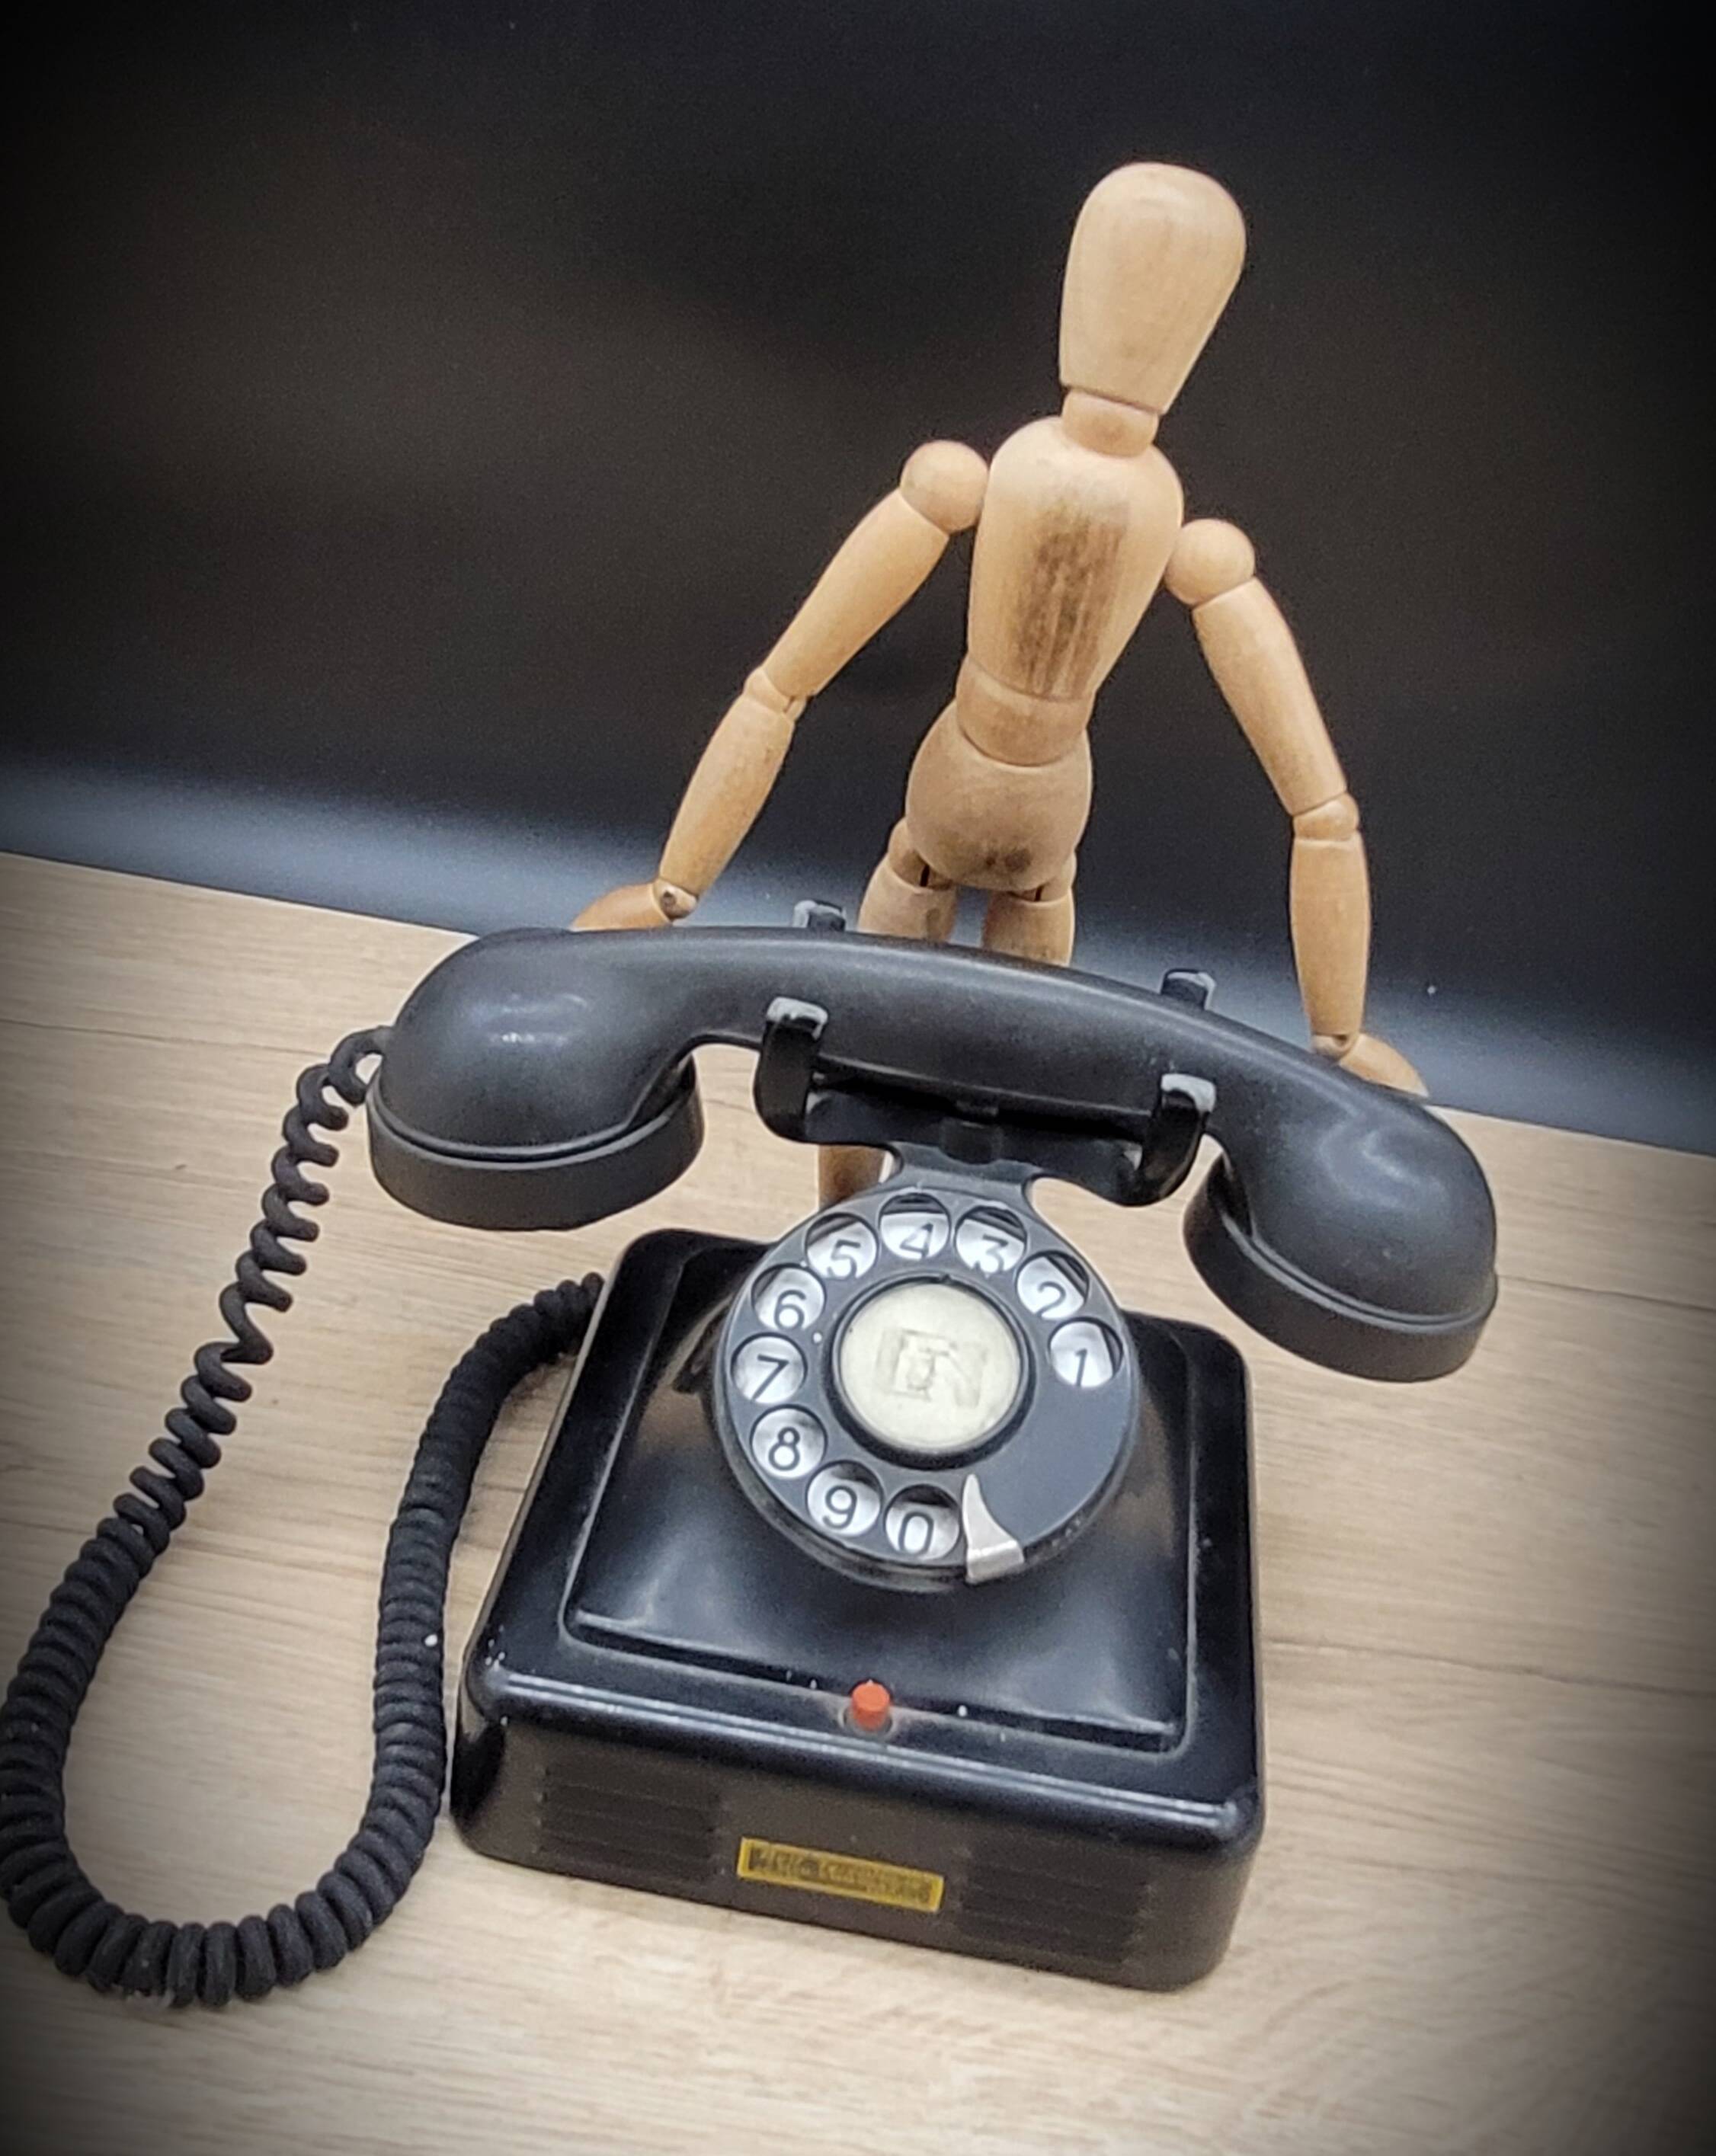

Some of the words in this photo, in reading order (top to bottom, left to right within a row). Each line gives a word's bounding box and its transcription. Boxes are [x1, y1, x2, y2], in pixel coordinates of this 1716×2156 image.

[828, 1240, 860, 1278] 5
[901, 1224, 933, 1259] 4
[974, 1235, 1007, 1272] 3
[774, 1291, 807, 1329] 6
[1039, 1282, 1066, 1318] 2
[752, 1355, 787, 1402] 7
[1073, 1349, 1088, 1387] 1
[768, 1427, 800, 1471] 8
[823, 1486, 856, 1530] 9
[899, 1511, 933, 1553] 0
